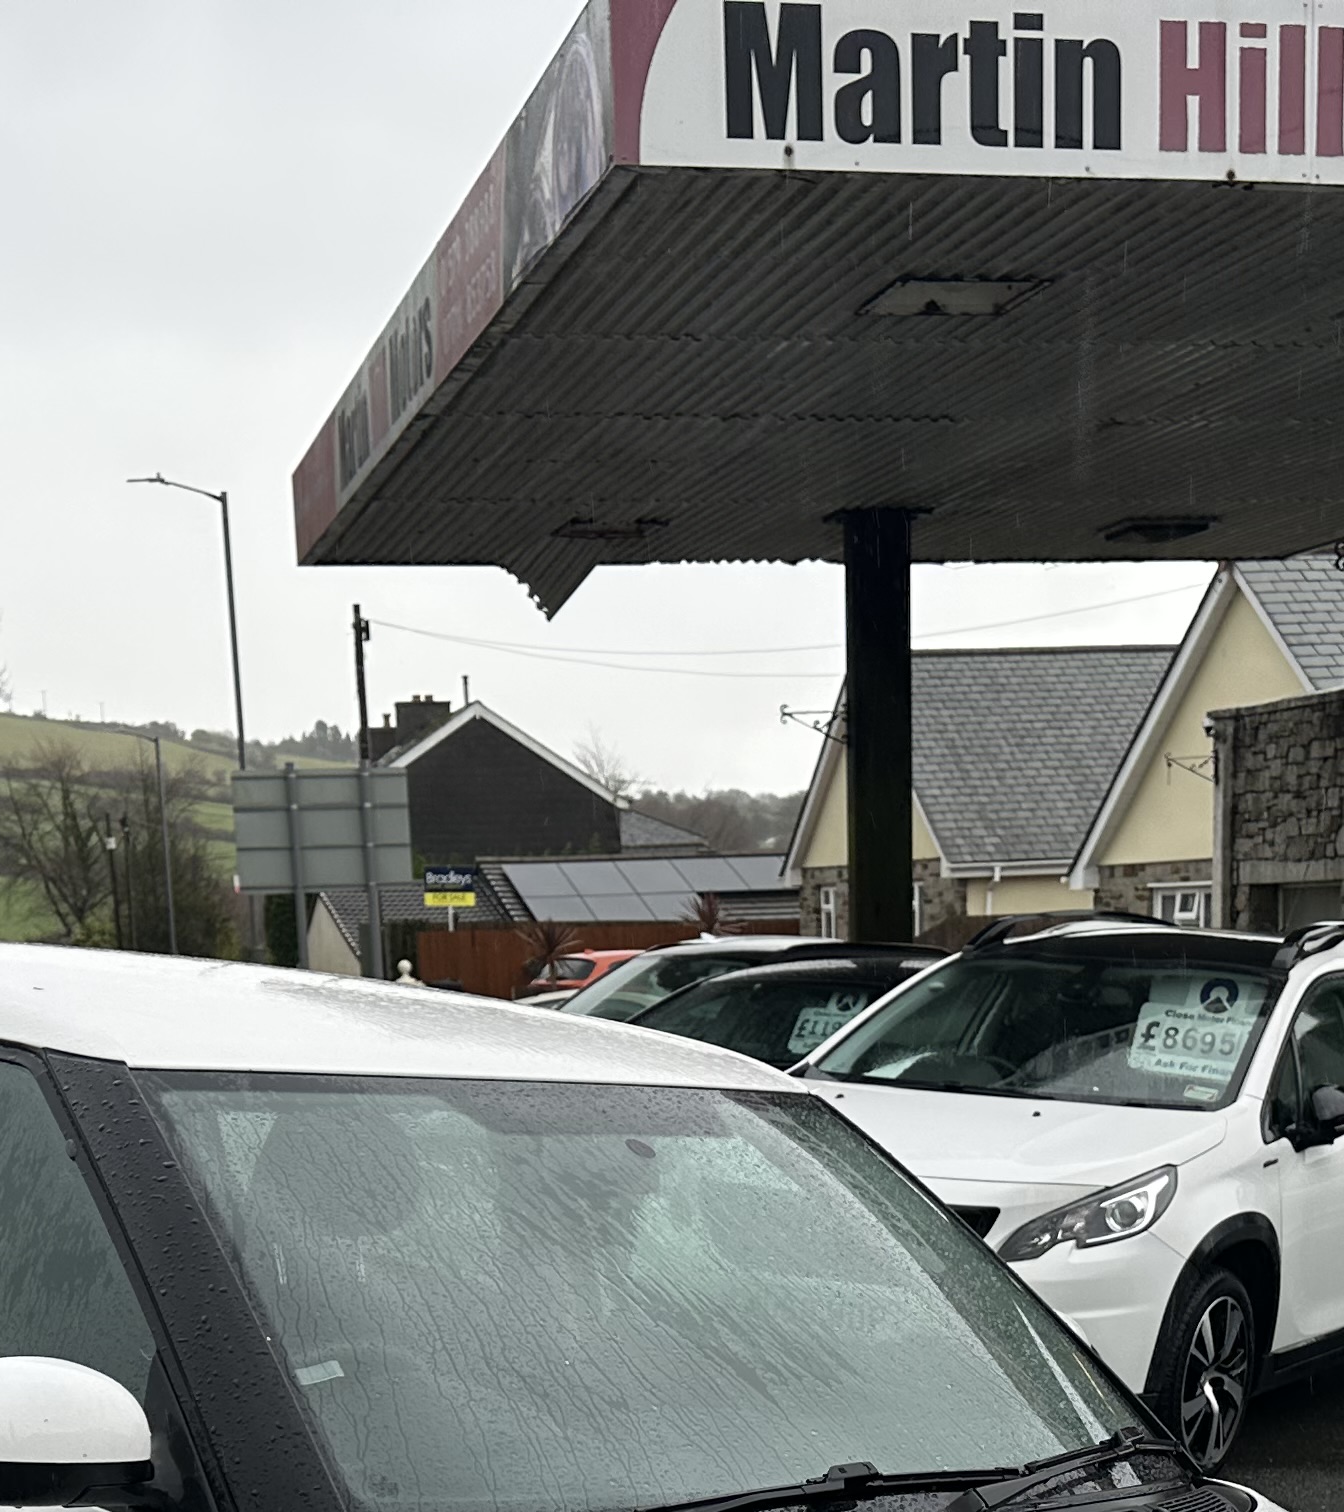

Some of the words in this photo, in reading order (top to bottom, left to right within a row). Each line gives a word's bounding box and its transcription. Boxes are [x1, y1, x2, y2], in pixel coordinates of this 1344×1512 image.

[723, 0, 1122, 151] Martin
[1158, 19, 1344, 157] Hill
[1164, 1008, 1195, 1021] Close
[1140, 1020, 1236, 1057] £8695
[1154, 1058, 1175, 1068] Ask
[1178, 1061, 1199, 1073] For
